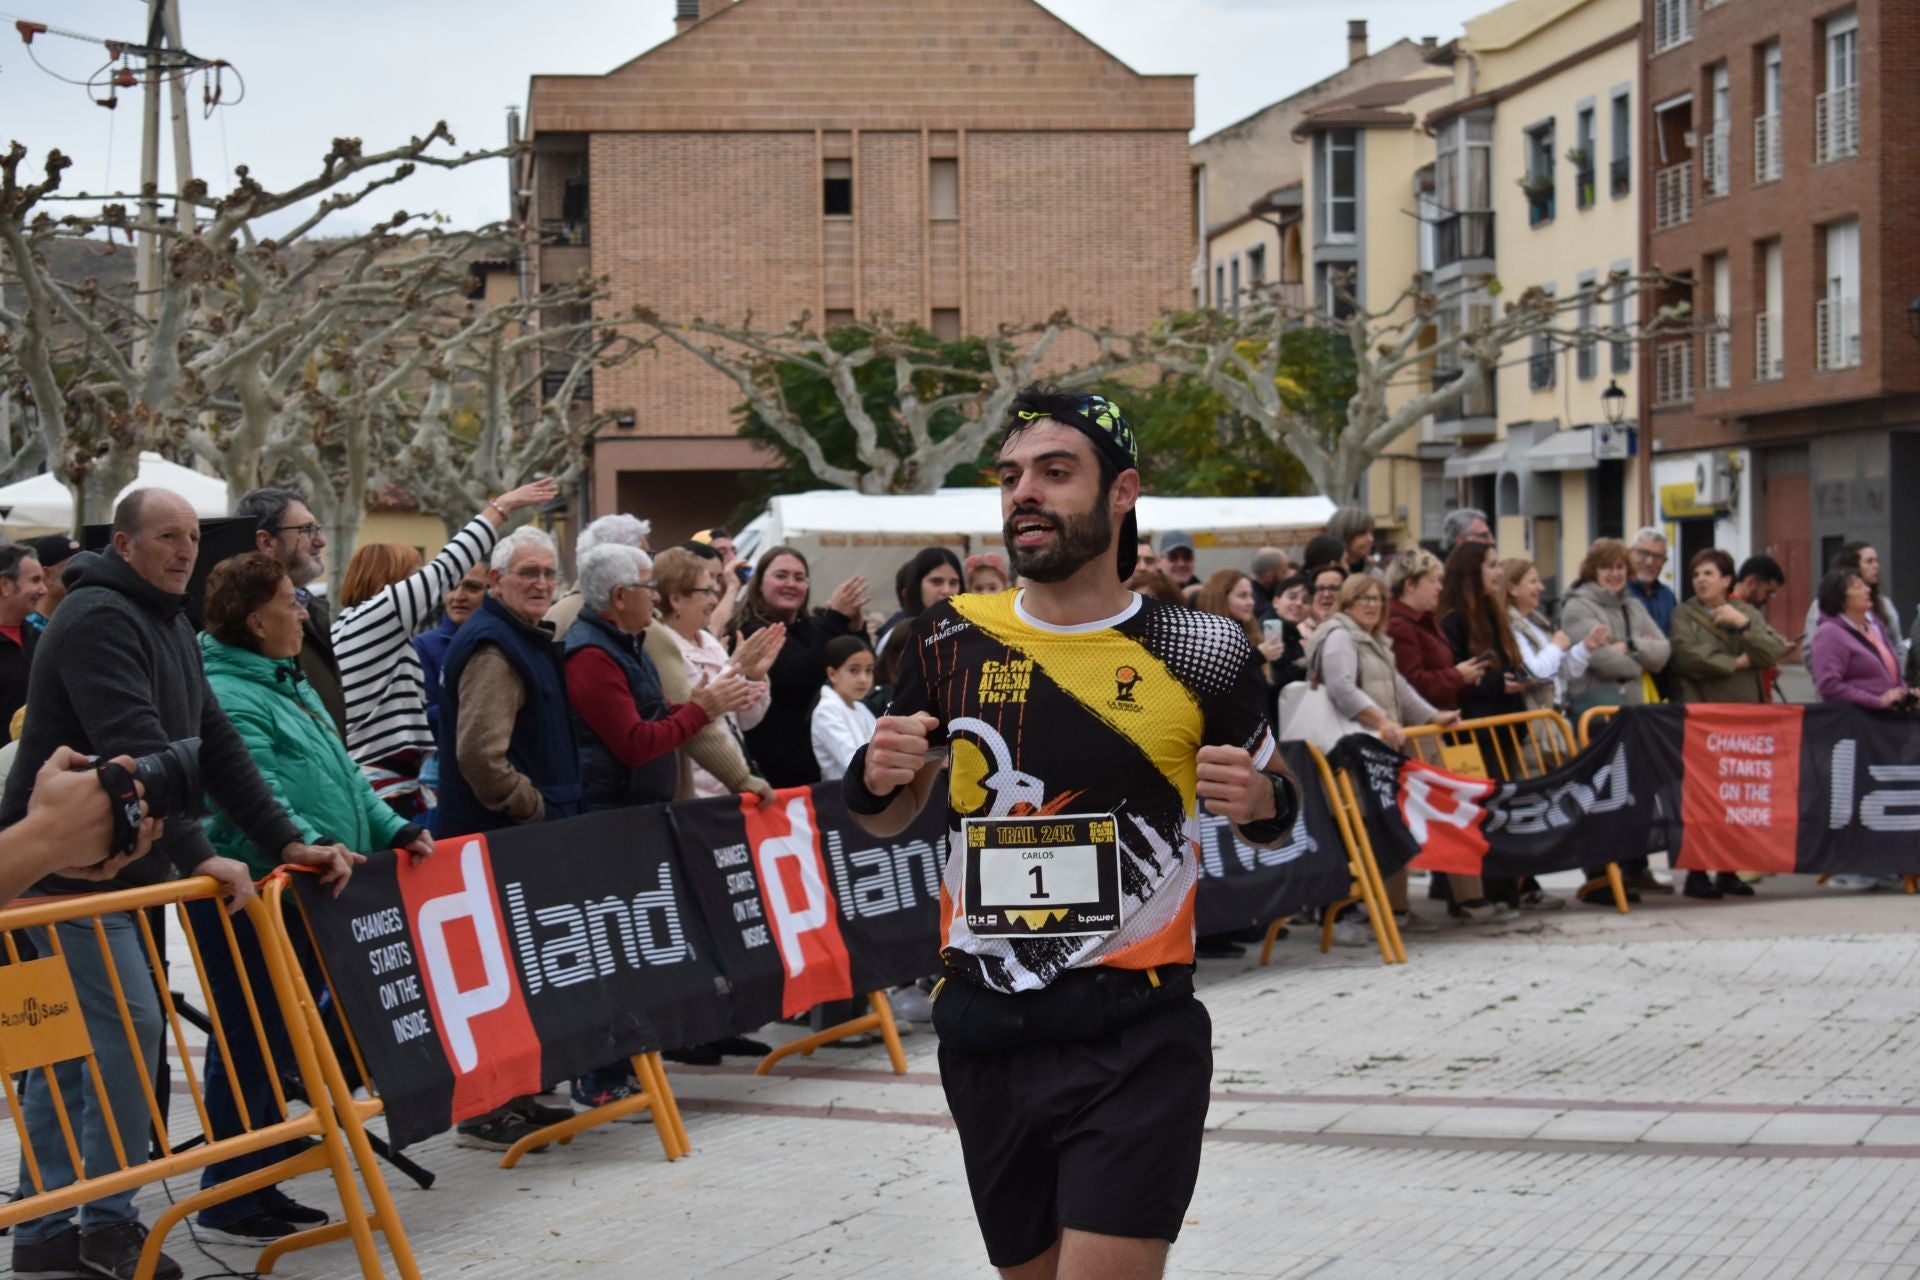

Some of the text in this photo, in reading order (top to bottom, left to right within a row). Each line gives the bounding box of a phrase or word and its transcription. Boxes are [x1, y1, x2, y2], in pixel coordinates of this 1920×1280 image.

[1707, 732, 1774, 755] CHANGES
[1718, 757, 1772, 779] STARTS
[1719, 782, 1771, 803] ON THE
[1725, 806, 1771, 827] INSIDE
[997, 823, 1076, 844] TRAIL 24K
[713, 843, 749, 868] CHANGES
[1021, 851, 1054, 860] CARLOS
[726, 870, 755, 895] STARTS
[827, 830, 946, 920] lan
[1028, 865, 1050, 899] 1
[733, 897, 761, 922] ON THE
[1078, 913, 1115, 925] b.power
[351, 907, 403, 943] CHANGES
[741, 924, 770, 949] INSIDE
[369, 941, 412, 975] STARTS
[379, 975, 420, 1010] ON THE
[392, 1009, 431, 1044] INSIDE
